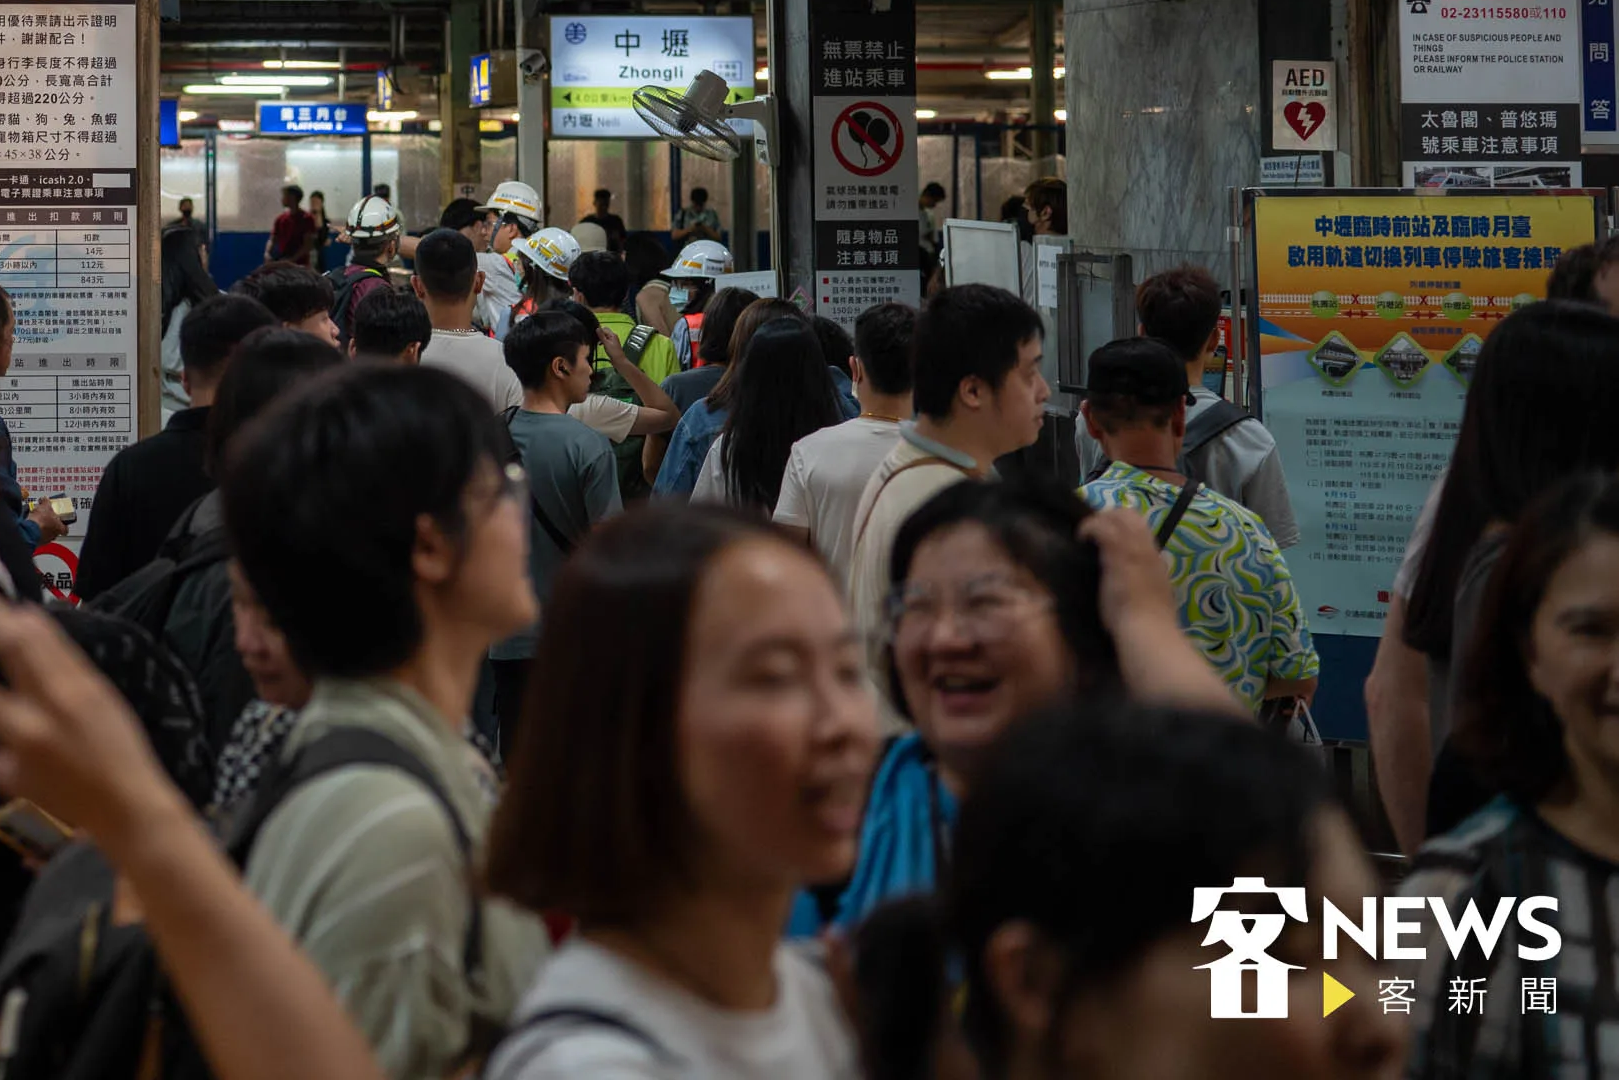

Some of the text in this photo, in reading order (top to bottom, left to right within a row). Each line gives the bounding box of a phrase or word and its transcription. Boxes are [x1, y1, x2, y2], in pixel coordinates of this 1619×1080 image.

[1441, 6, 1567, 20] 02-23115580或110
[615, 28, 690, 58] 中壢
[1412, 33, 1561, 42] IN CASE OF SUSPICIOUS PEOPLE AND
[823, 40, 906, 60] 無票禁止
[1413, 44, 1444, 53] THINGS
[1413, 55, 1564, 63] PLEASE INFORM THE POLICE STATION
[619, 65, 684, 81] Zhongli
[1285, 68, 1324, 86] AED
[1413, 65, 1463, 74] OR RAILWAY
[823, 68, 906, 87] 進站乘車
[1421, 110, 1558, 129] 太魯閣、普悠瑪
[1422, 135, 1558, 154] 號乘車注意事項
[1315, 215, 1532, 238] 中壢臨時前站及臨時月臺
[83, 232, 101, 242] 扣款
[836, 229, 899, 245] 隨身物品
[85, 247, 104, 256] 14元
[836, 250, 899, 265] 注意事項
[81, 260, 104, 270] 112元
[81, 275, 104, 284] 843元
